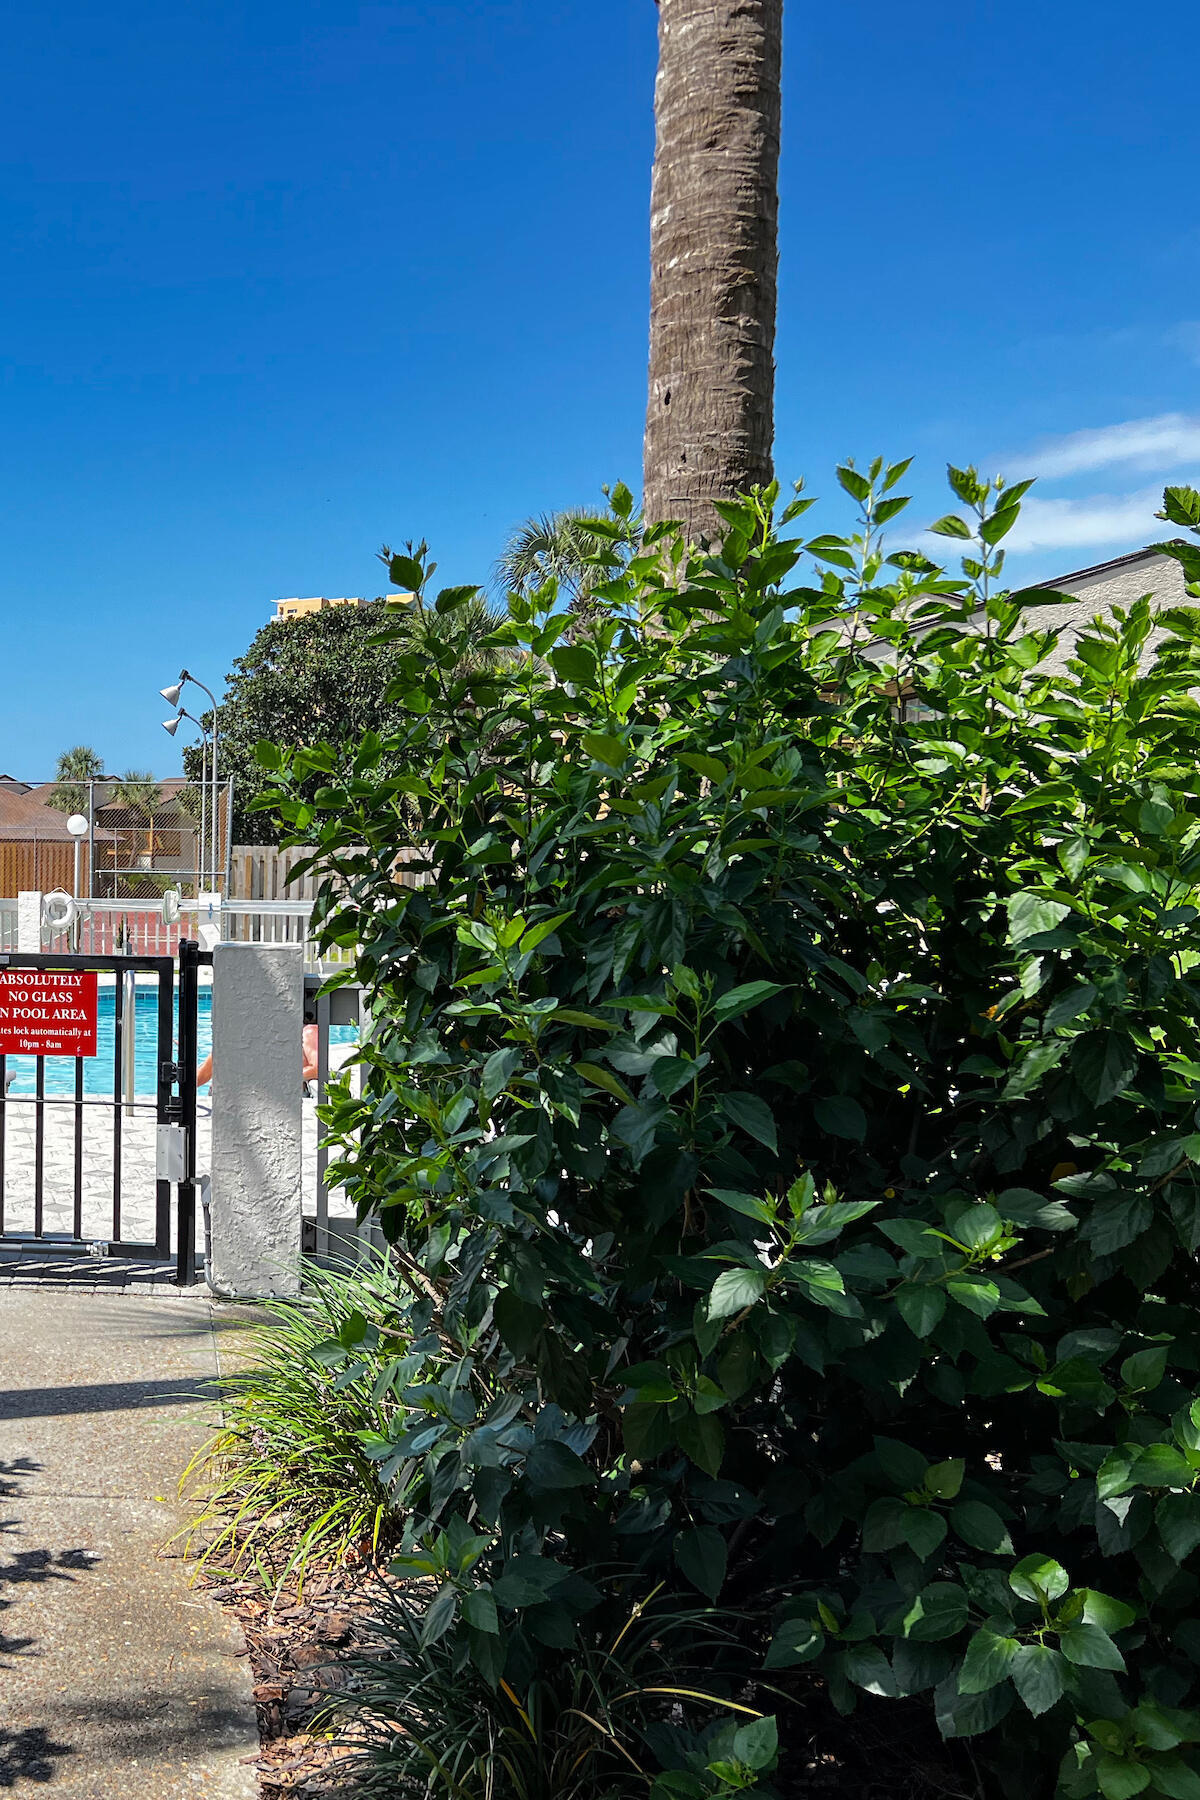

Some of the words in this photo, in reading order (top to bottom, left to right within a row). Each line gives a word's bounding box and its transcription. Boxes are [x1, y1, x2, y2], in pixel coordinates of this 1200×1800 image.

[0, 974, 83, 986] ABSOLUTELY
[8, 991, 29, 1002] NO
[31, 991, 73, 1003] GLASS
[12, 1008, 49, 1020] POOL
[52, 1009, 87, 1020] AREA
[13, 1026, 29, 1035] lock
[30, 1027, 81, 1039] automatically
[83, 1029, 91, 1037] at
[19, 1039, 39, 1050] 10pm
[45, 1039, 62, 1048] 8am
